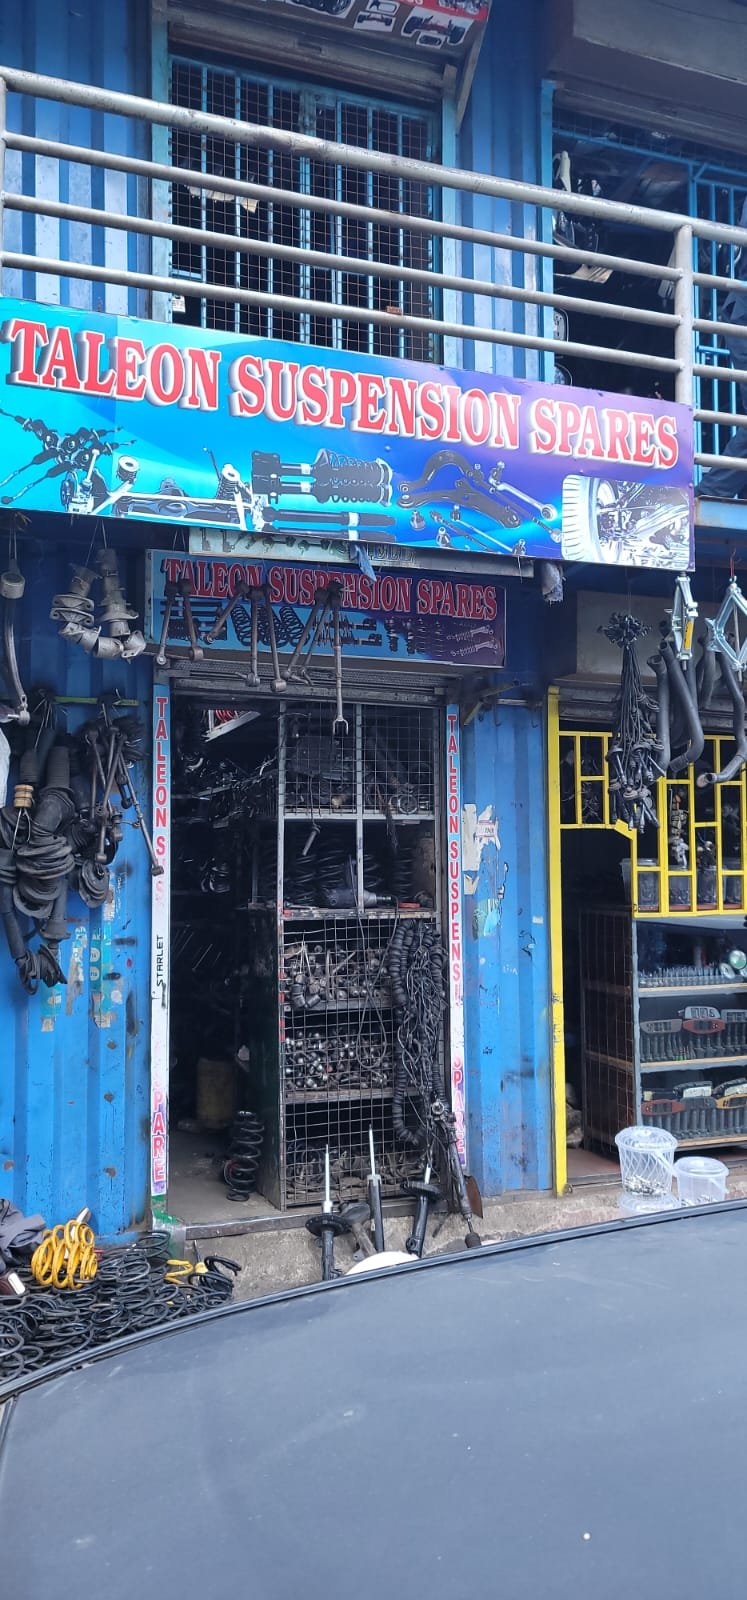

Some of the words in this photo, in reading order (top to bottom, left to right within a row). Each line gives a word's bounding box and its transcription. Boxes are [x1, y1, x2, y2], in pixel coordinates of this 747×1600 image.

[2, 318, 222, 412] TALEON
[228, 354, 522, 450] SUSPENSION
[528, 398, 679, 470] SPARES
[162, 558, 263, 600] TALEON
[417, 578, 498, 621] SPARES
[155, 697, 169, 828] TALEON
[447, 715, 459, 834] TALEON
[156, 934, 164, 988] STARLET
